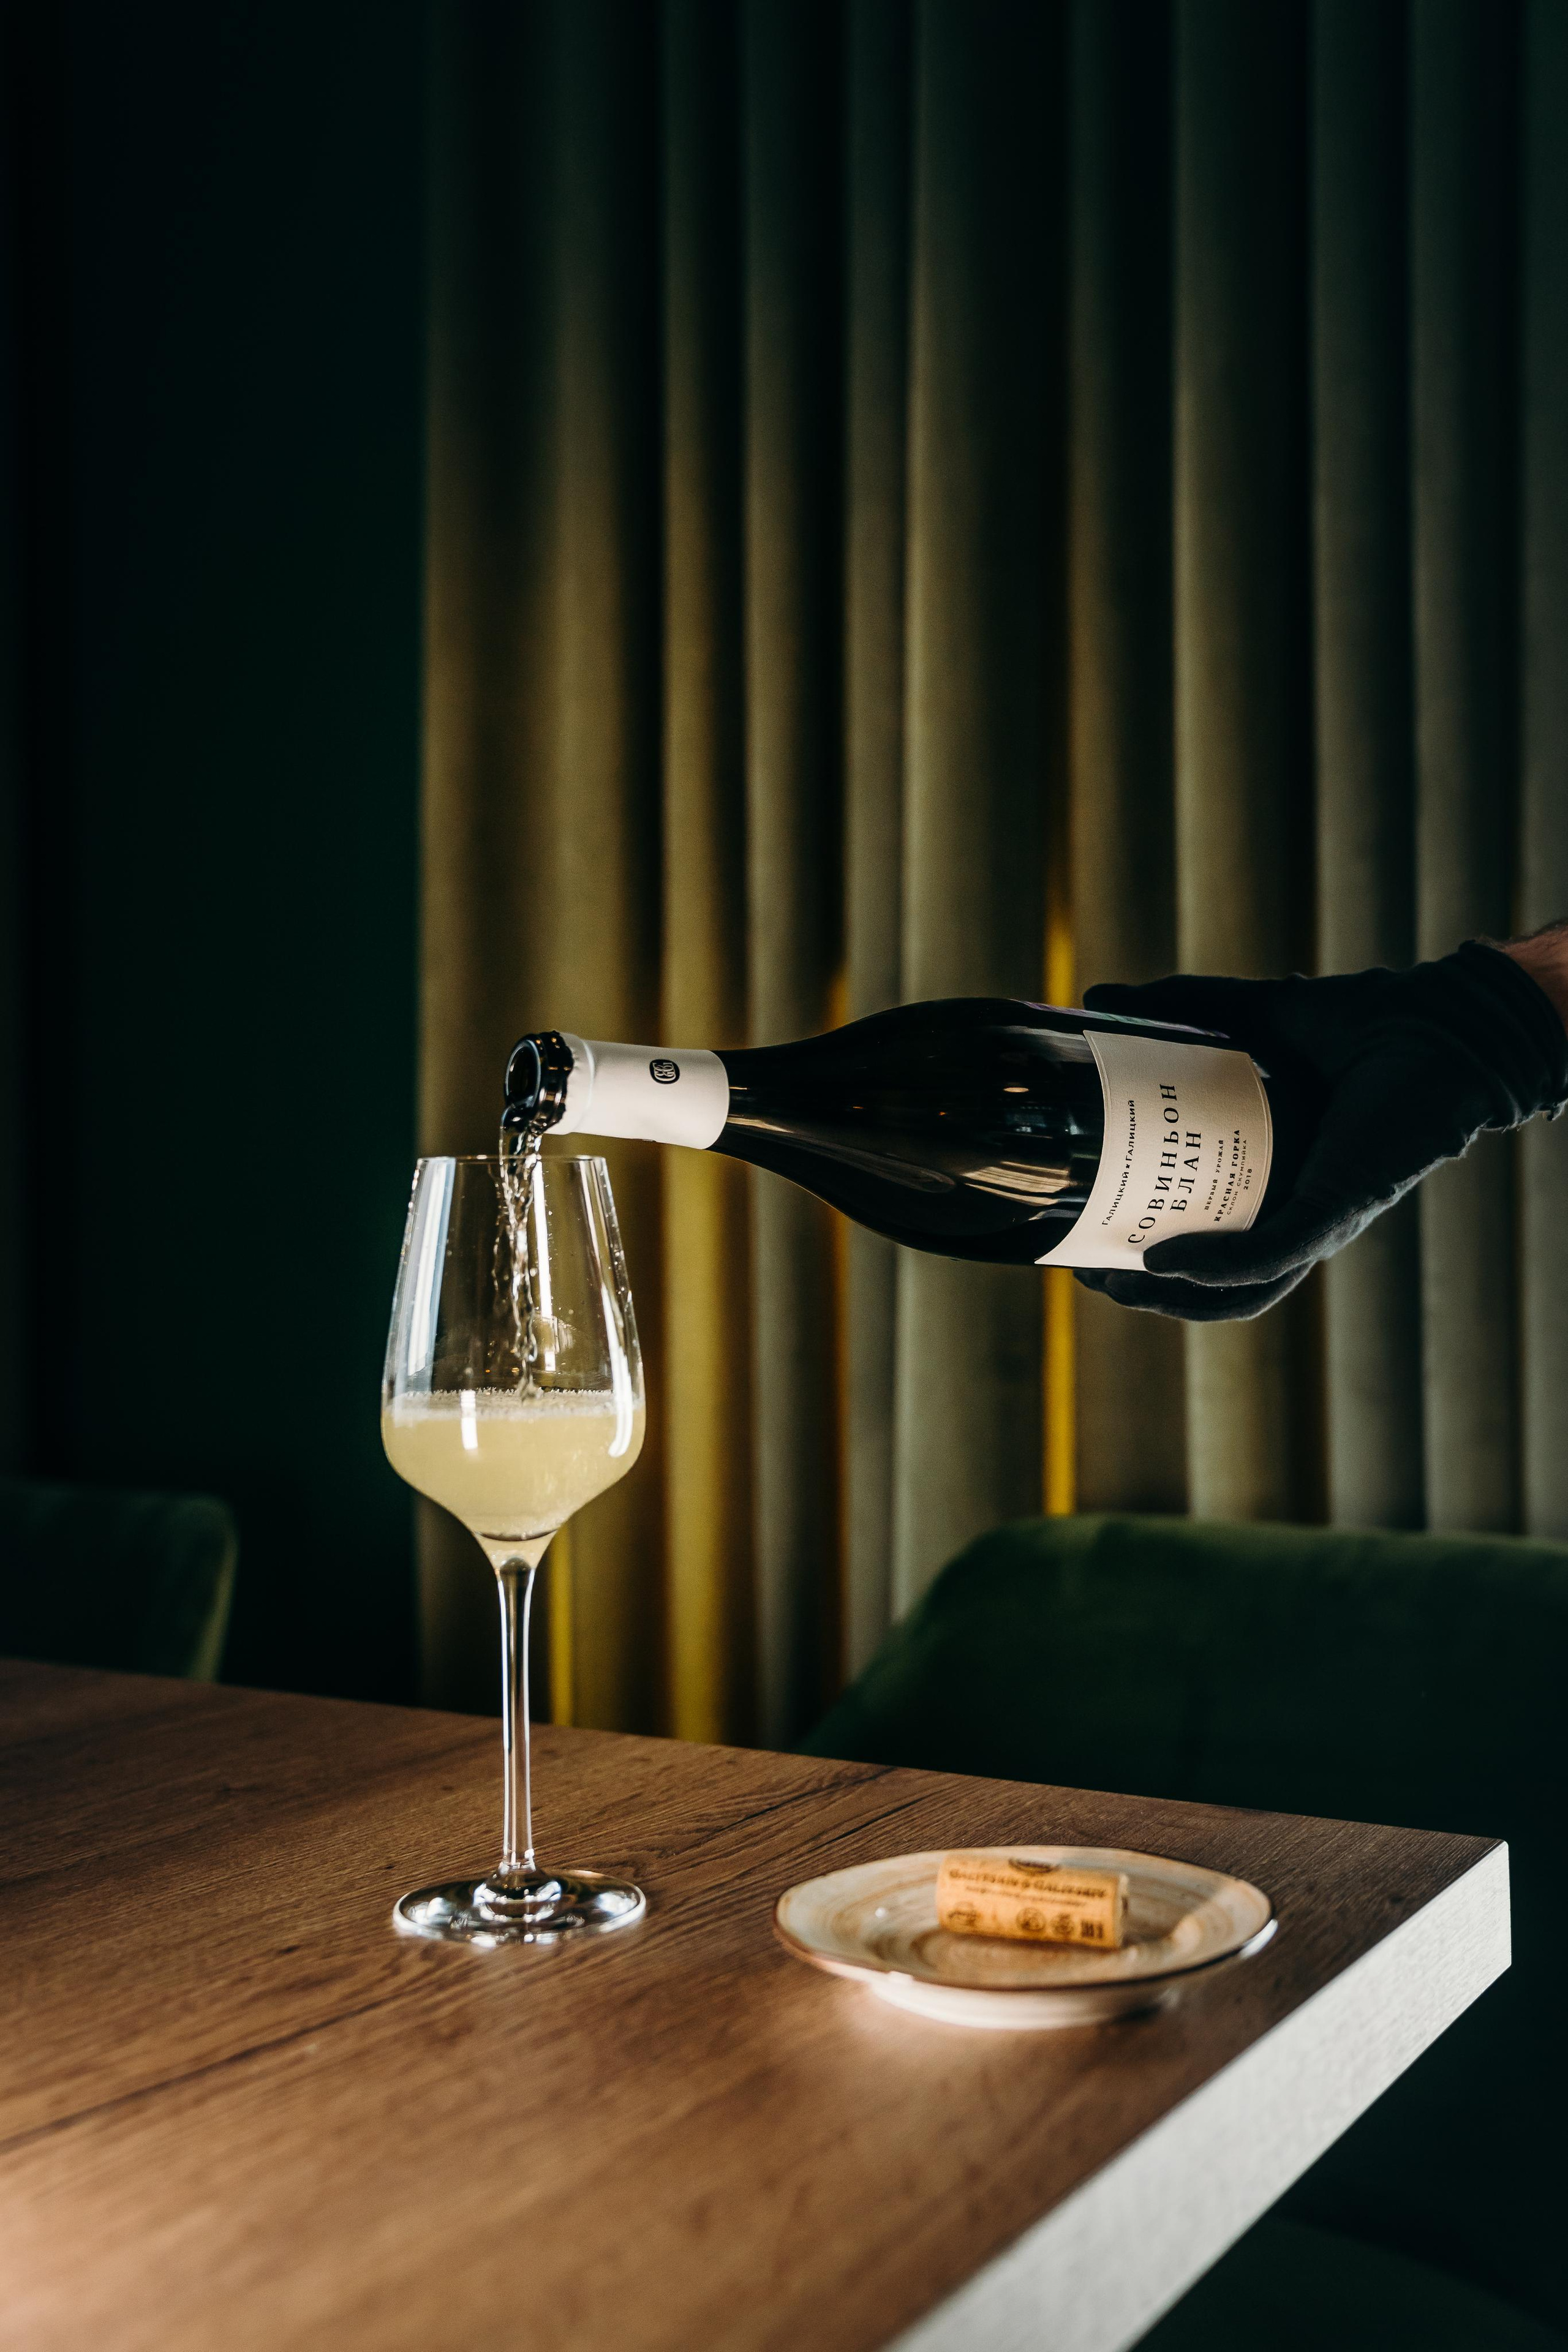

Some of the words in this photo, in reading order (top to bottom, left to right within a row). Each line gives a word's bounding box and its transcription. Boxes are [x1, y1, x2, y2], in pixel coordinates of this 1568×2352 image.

[1128, 1084, 1180, 1244] СОВИНЬОН
[1169, 1131, 1202, 1212] БЛАН
[1204, 1178, 1218, 1210] ПЕРВЫЙ
[1216, 1139, 1224, 1174] УРОЖАЙ
[1214, 1172, 1236, 1222] КРАСНАЯ
[1232, 1129, 1240, 1167] ГОРКА
[1243, 1167, 1253, 1190] 2018
[1227, 1191, 1238, 1216] СКЛОН
